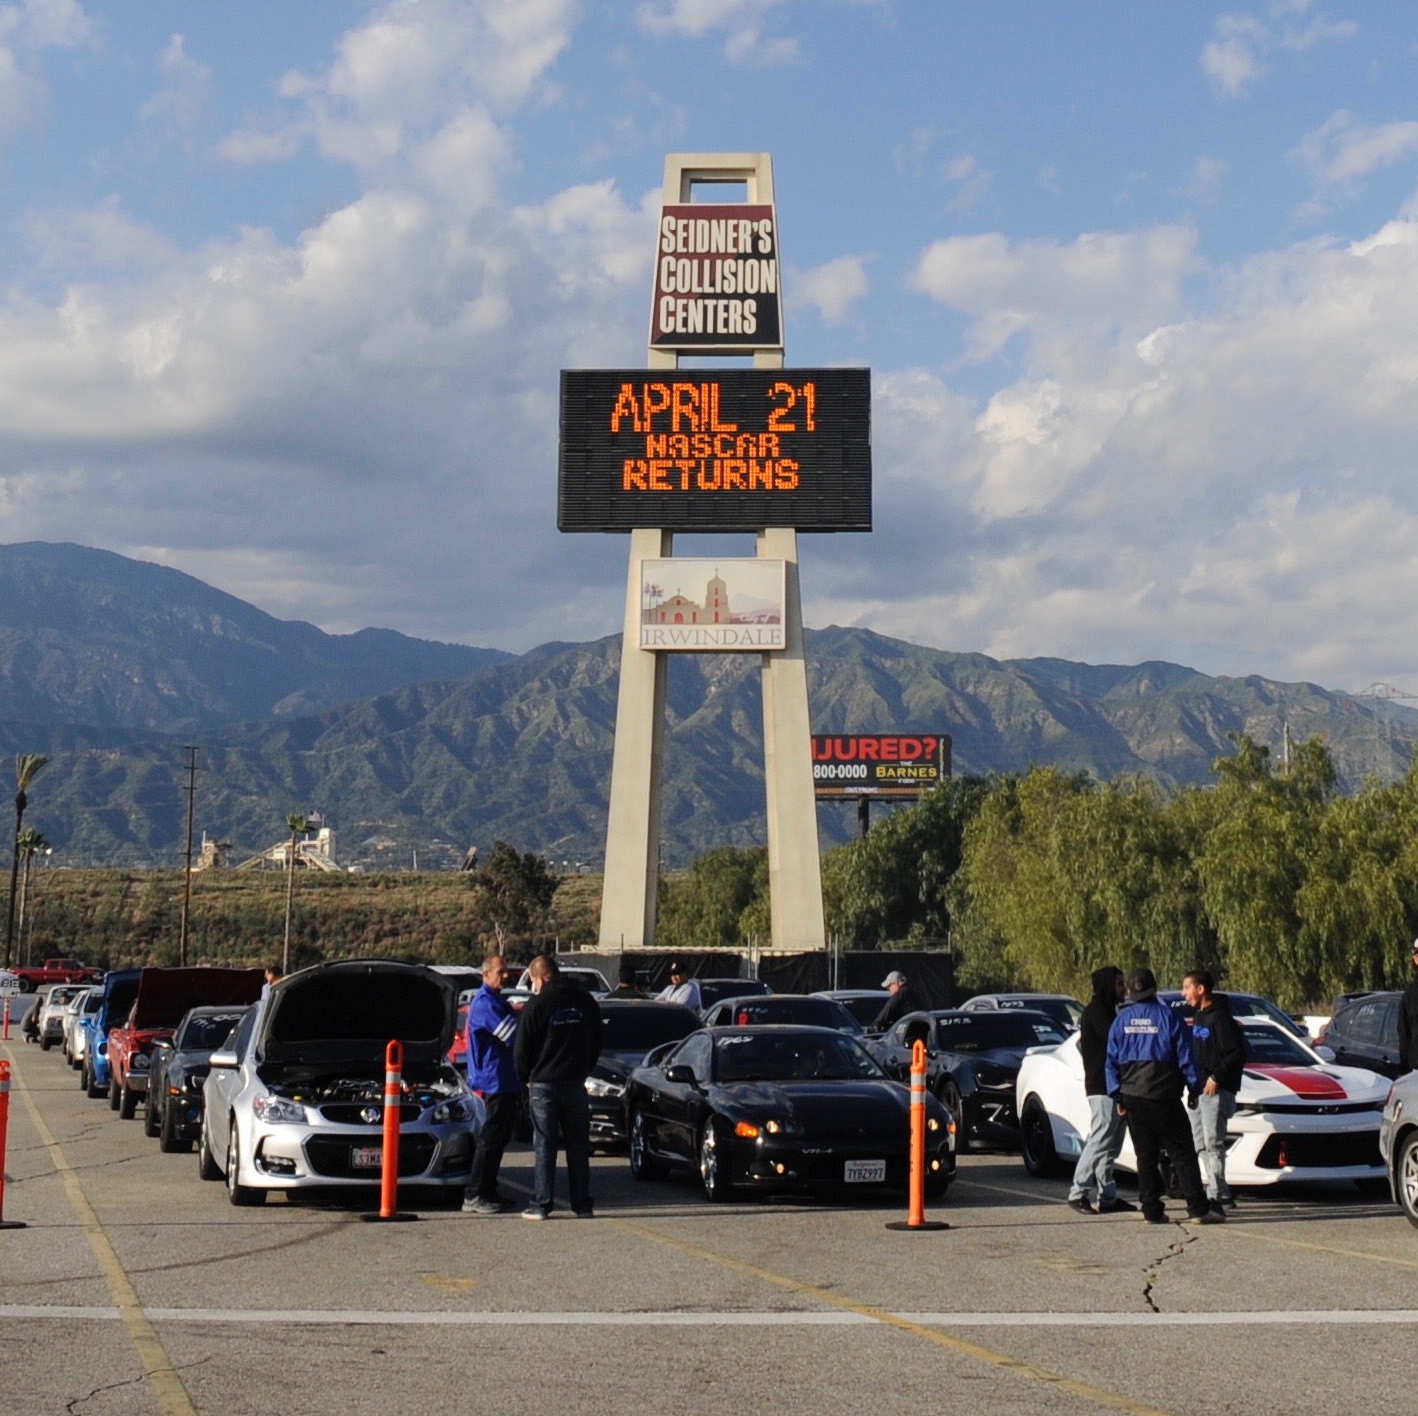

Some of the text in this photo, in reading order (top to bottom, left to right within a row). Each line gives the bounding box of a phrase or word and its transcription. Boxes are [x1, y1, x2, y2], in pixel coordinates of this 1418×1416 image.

[661, 215, 772, 254] SEIDNER'S
[660, 255, 776, 294] COLLISION
[659, 295, 757, 334] CENTERS
[611, 382, 816, 432] APRIL 21
[646, 433, 780, 458] NASCAR
[623, 459, 799, 490] RETURNS
[644, 629, 782, 646] IRWINDALE
[875, 766, 938, 778] BARNES
